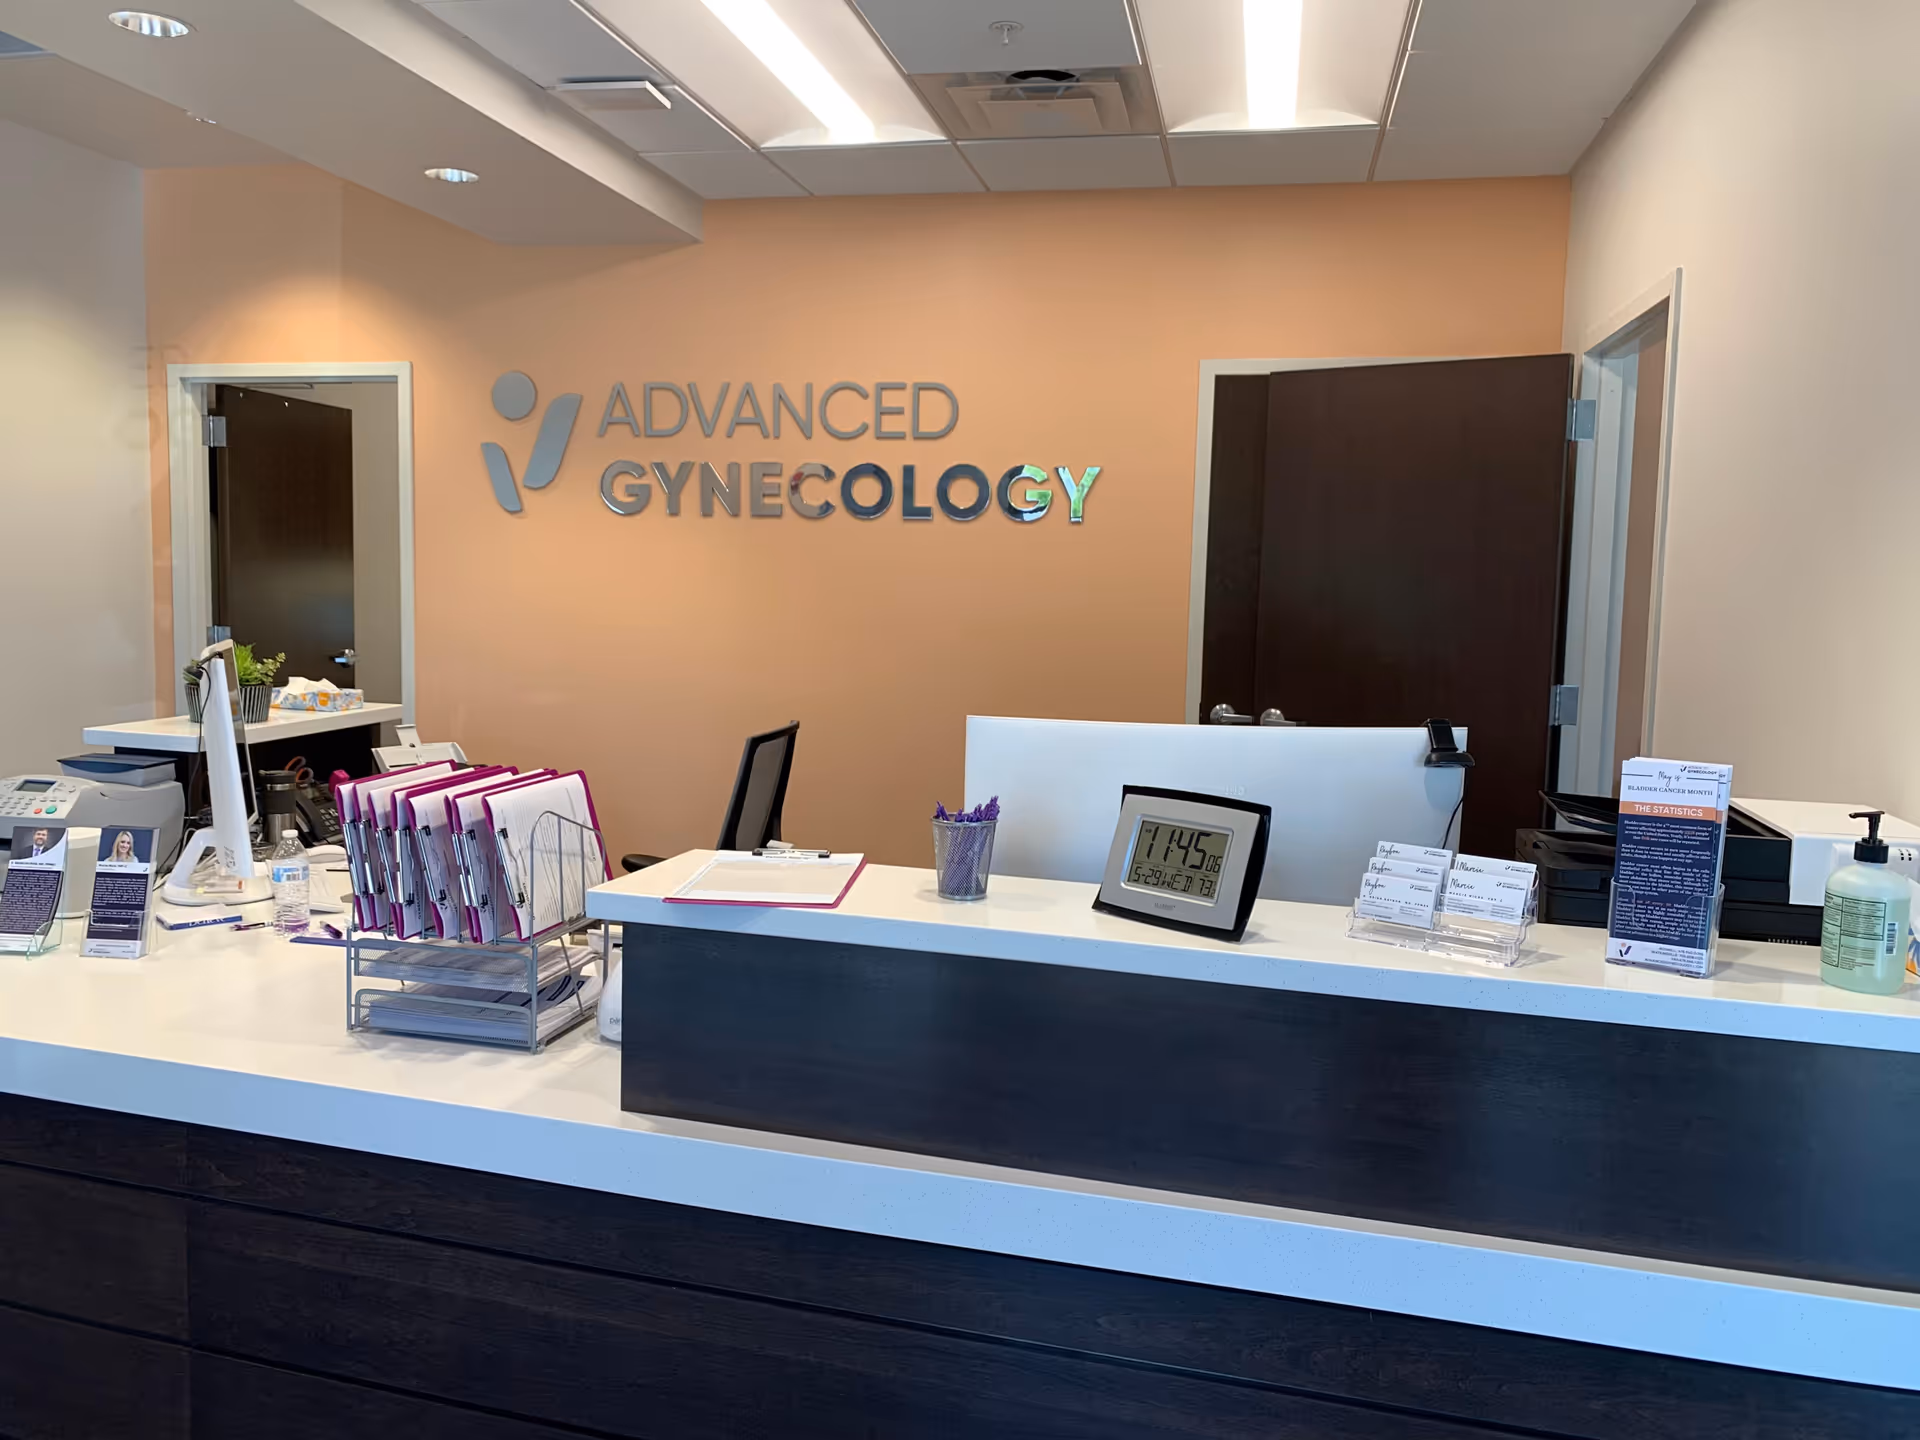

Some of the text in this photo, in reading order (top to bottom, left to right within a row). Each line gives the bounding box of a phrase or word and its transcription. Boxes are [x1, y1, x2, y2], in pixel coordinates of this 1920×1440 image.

[598, 380, 959, 441] ADVANCED
[600, 459, 1102, 524] GYNECOLOGY
[1658, 771, 1672, 787] May
[1634, 804, 1703, 817] THE STATISTICS
[1146, 826, 1213, 870] 11:45
[1205, 855, 1223, 873] 06
[1133, 866, 1162, 886] 5-29
[1161, 872, 1193, 892] WED
